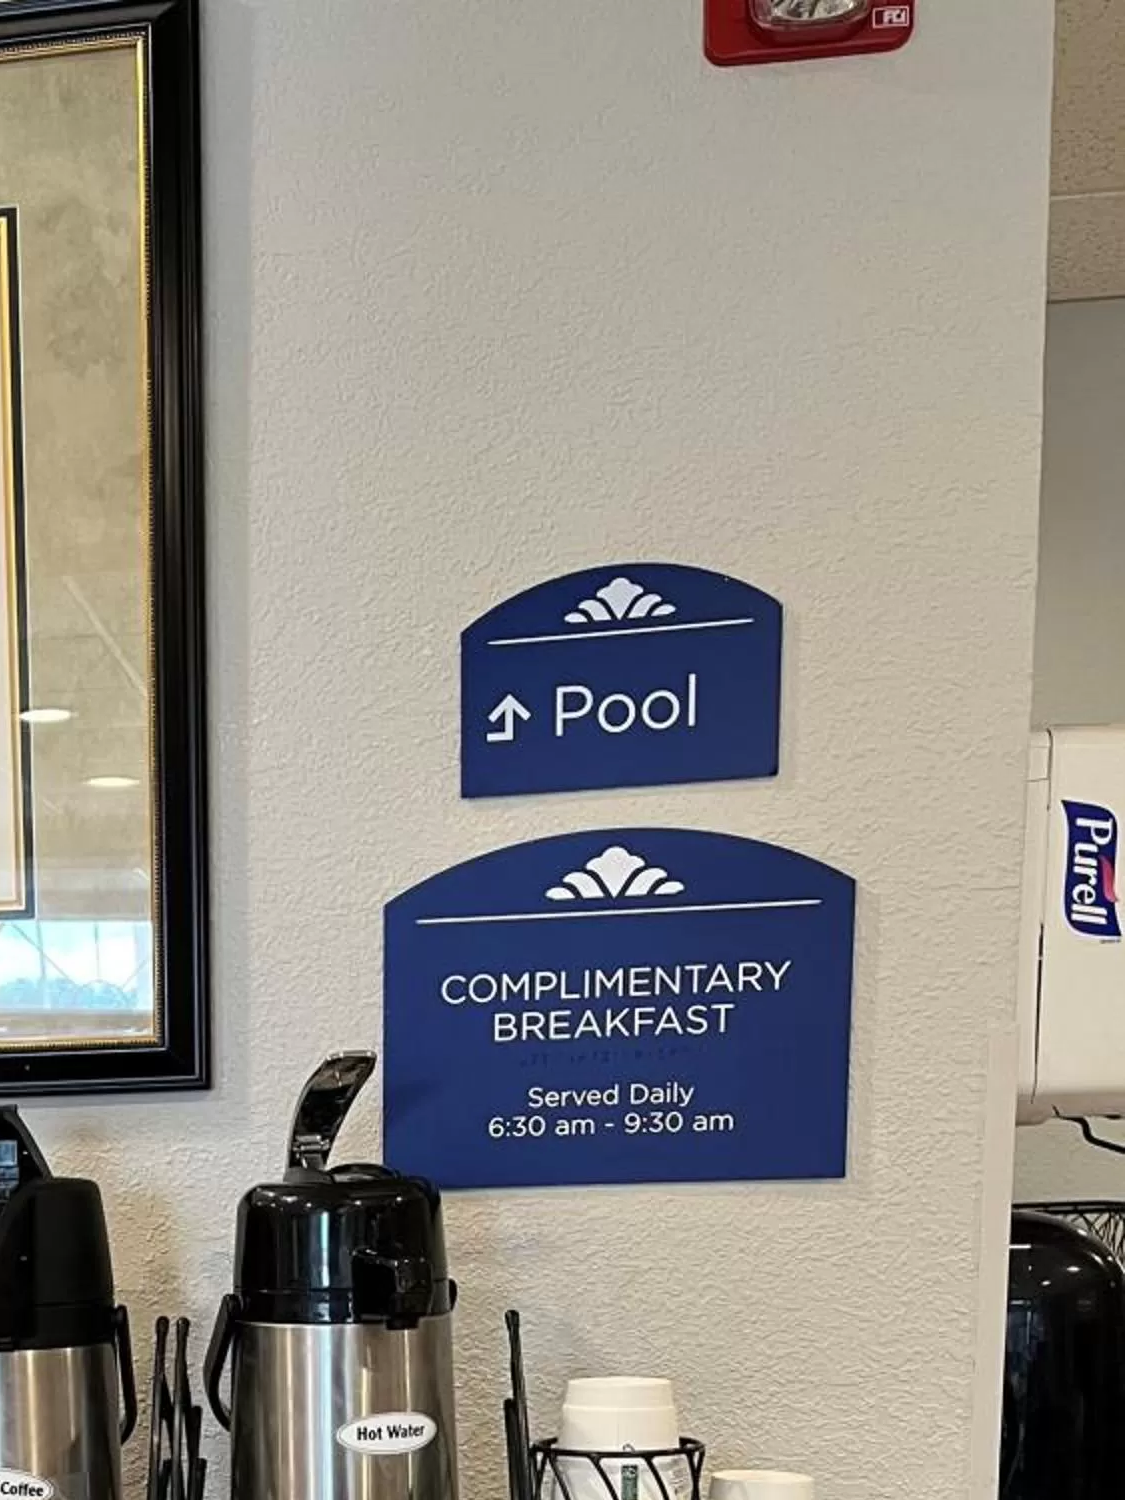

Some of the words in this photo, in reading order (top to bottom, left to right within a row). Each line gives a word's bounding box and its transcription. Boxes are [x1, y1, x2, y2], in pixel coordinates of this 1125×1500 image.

[555, 673, 697, 737] Pool
[1071, 817, 1114, 925] Purell
[440, 960, 792, 1004] COMPLIMENTARY
[493, 1003, 735, 1043] BREAKFAST
[528, 1084, 619, 1108] Served
[630, 1081, 695, 1107] Daily
[488, 1115, 546, 1138] 6:30
[555, 1118, 595, 1136] am
[625, 1112, 683, 1134] 9:30
[692, 1113, 734, 1132] am
[356, 1425, 383, 1441] Hot
[386, 1424, 426, 1439] Water
[0, 1481, 44, 1497] Coffee
